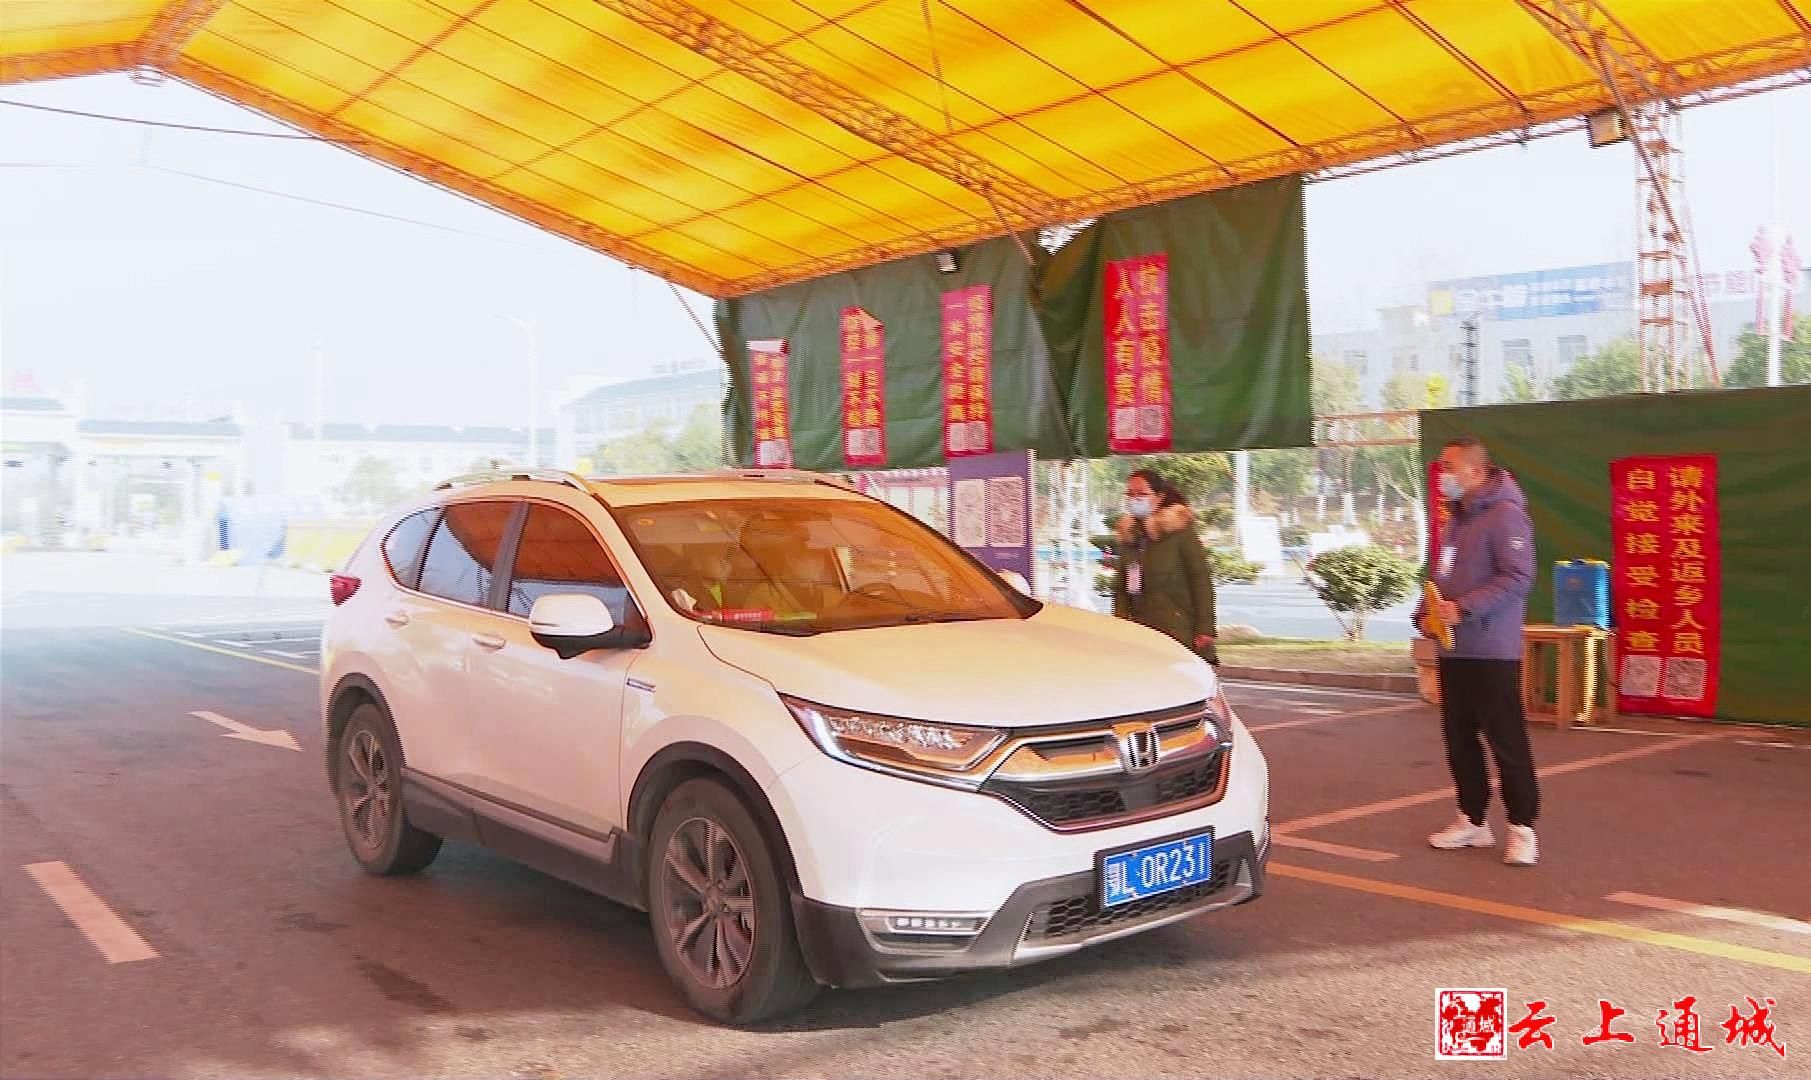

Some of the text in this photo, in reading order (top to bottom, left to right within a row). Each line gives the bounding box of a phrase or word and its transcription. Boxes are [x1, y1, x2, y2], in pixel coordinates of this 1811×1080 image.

[1113, 268, 1136, 406] 人人有责
[1138, 263, 1163, 404] 抗击疫情
[1623, 467, 1662, 652] 自觉接受检查
[1666, 465, 1707, 655] 请外来及返乡人员
